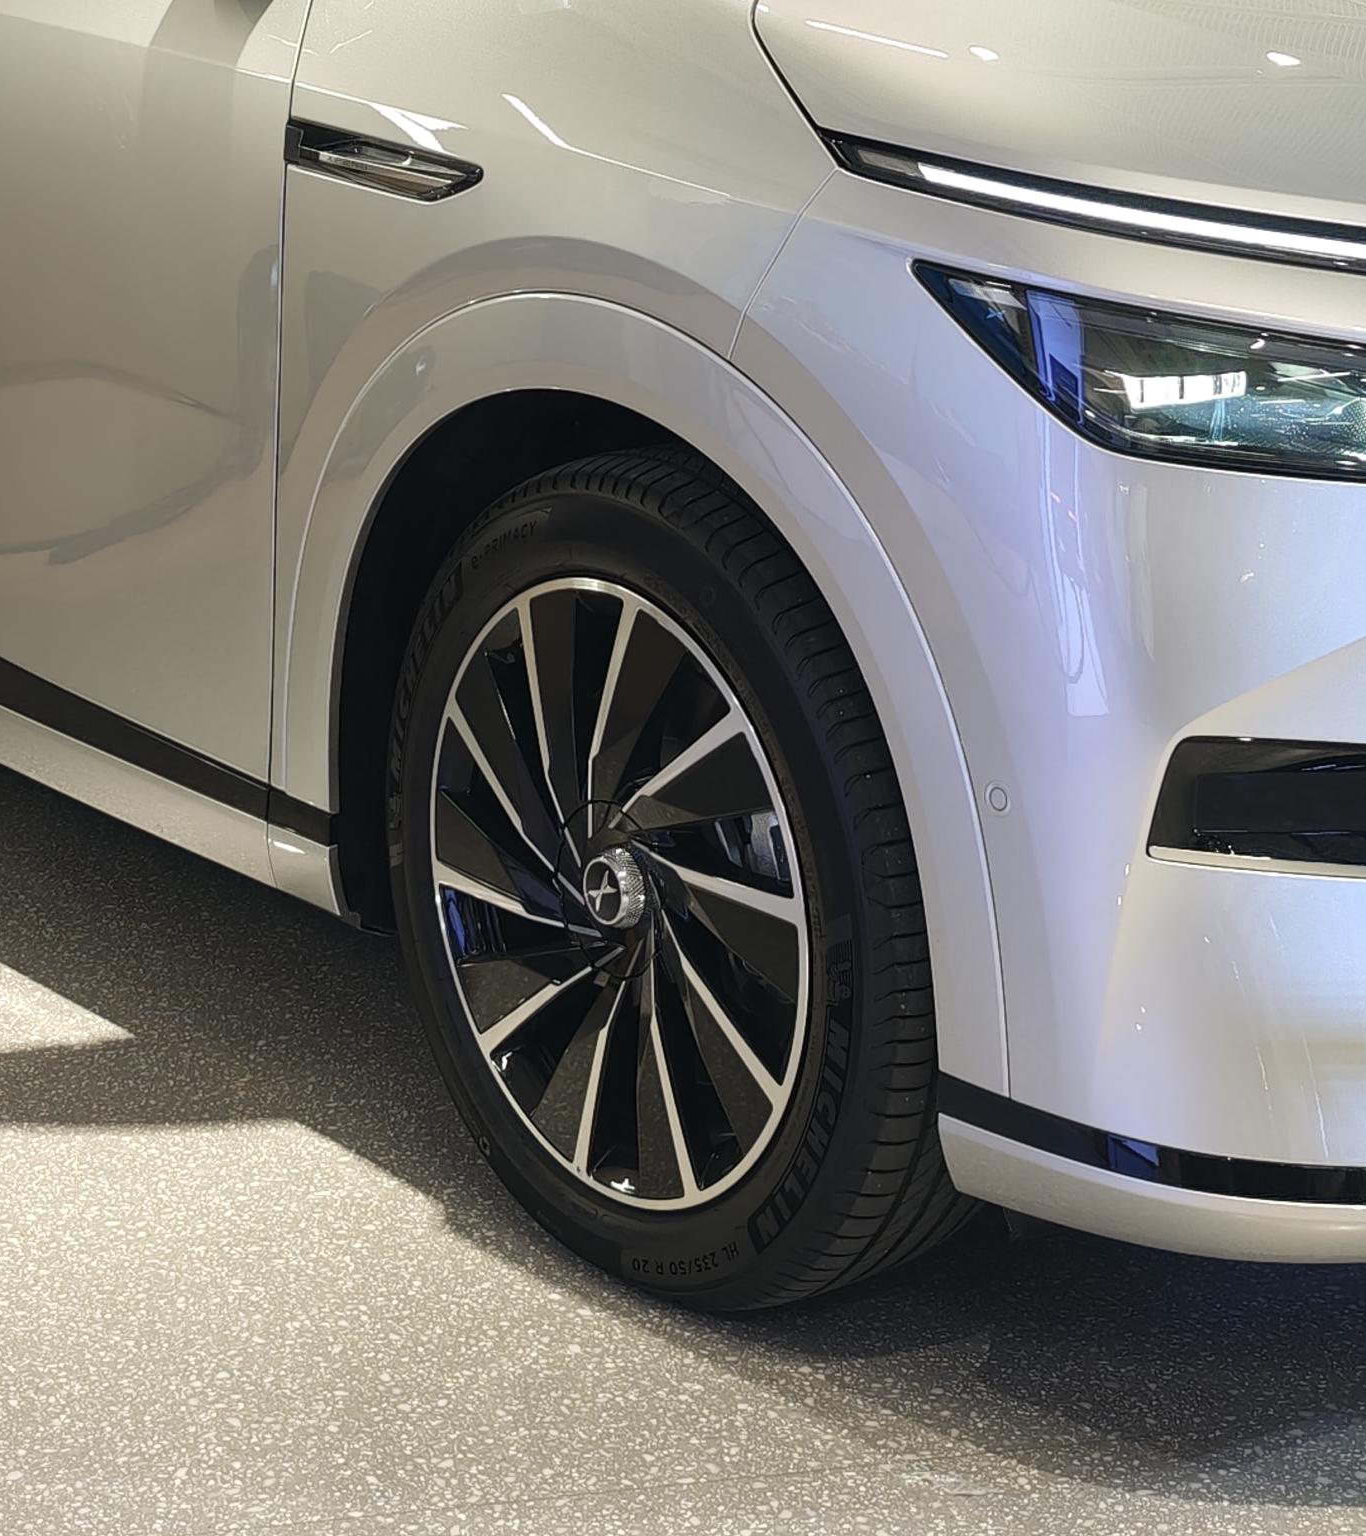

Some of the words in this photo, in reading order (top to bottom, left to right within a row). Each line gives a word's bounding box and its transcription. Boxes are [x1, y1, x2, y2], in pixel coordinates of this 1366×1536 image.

[388, 568, 463, 781] MICHELIN
[755, 1020, 851, 1244] MICHELIN
[631, 1258, 651, 1273] 20
[669, 1251, 719, 1276] 235/50
